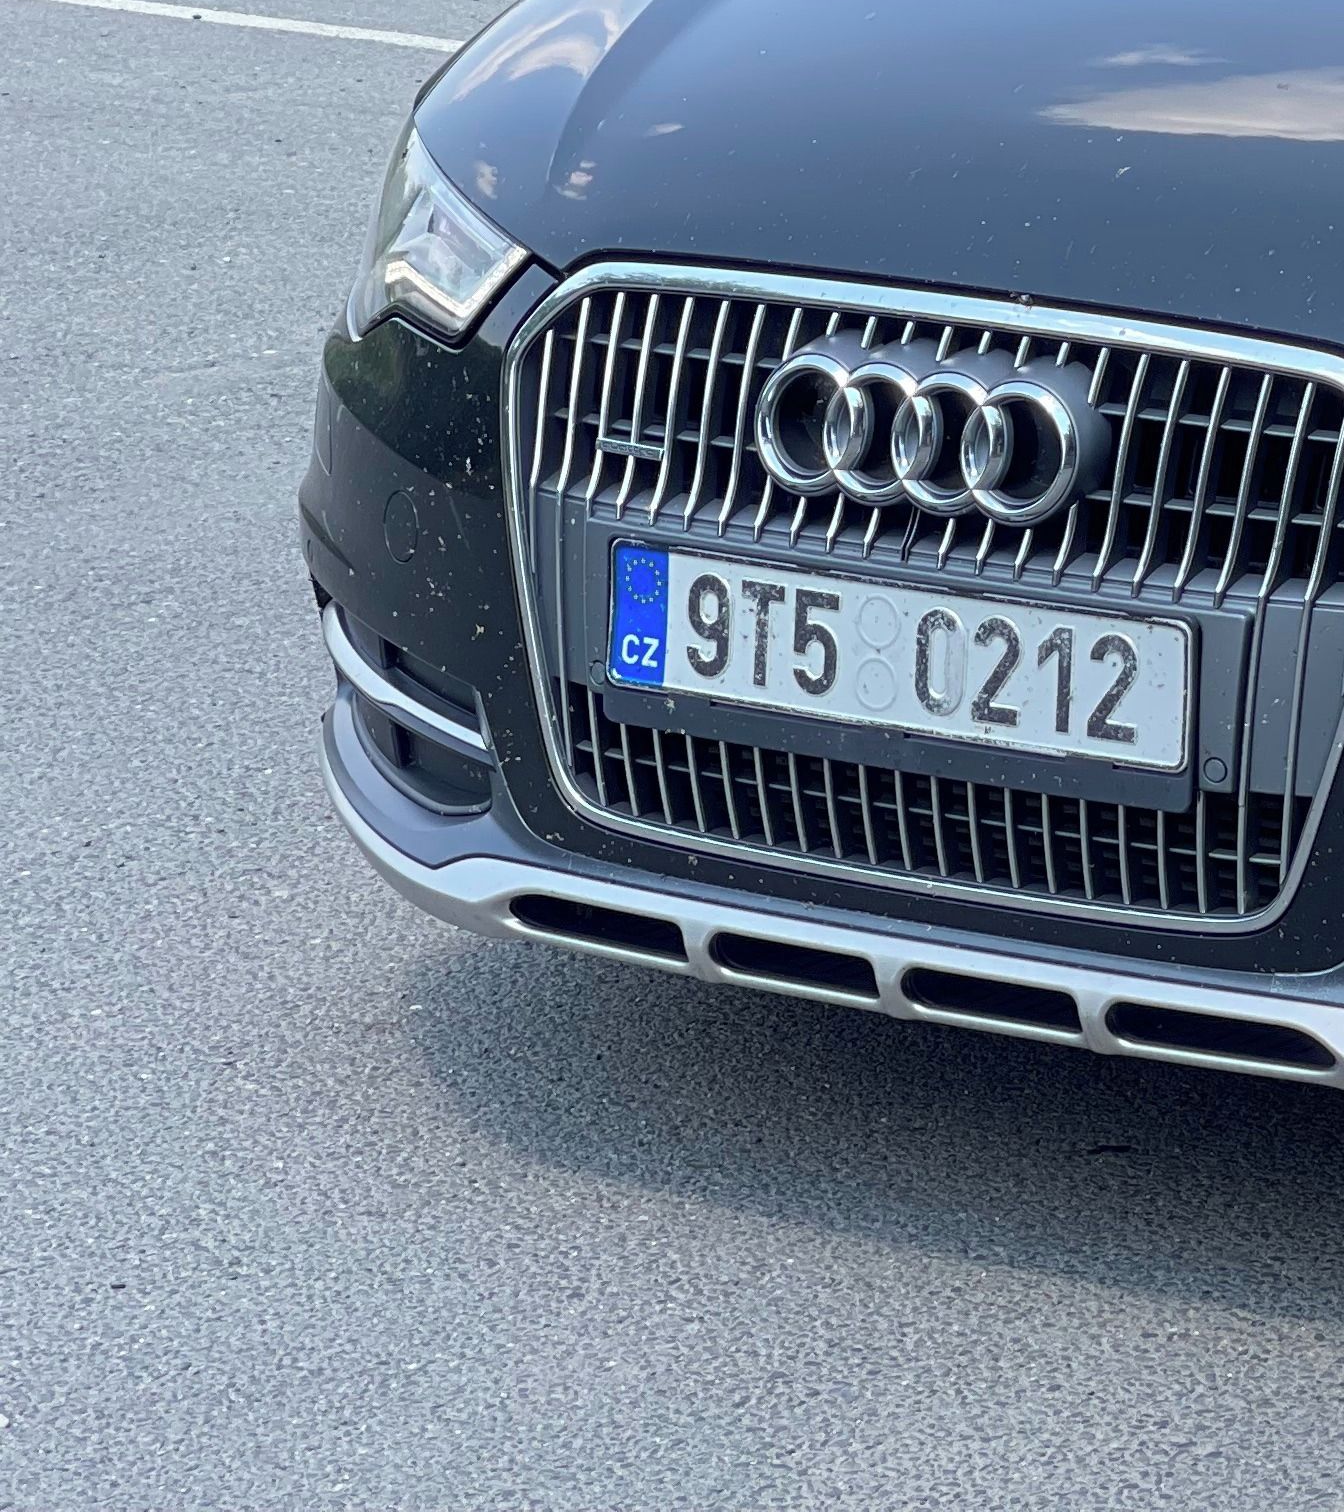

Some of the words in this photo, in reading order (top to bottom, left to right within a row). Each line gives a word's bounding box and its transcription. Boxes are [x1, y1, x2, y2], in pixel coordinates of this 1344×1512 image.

[621, 634, 659, 669] CZ
[686, 572, 841, 697] 9T5
[914, 605, 1138, 745] 0212
